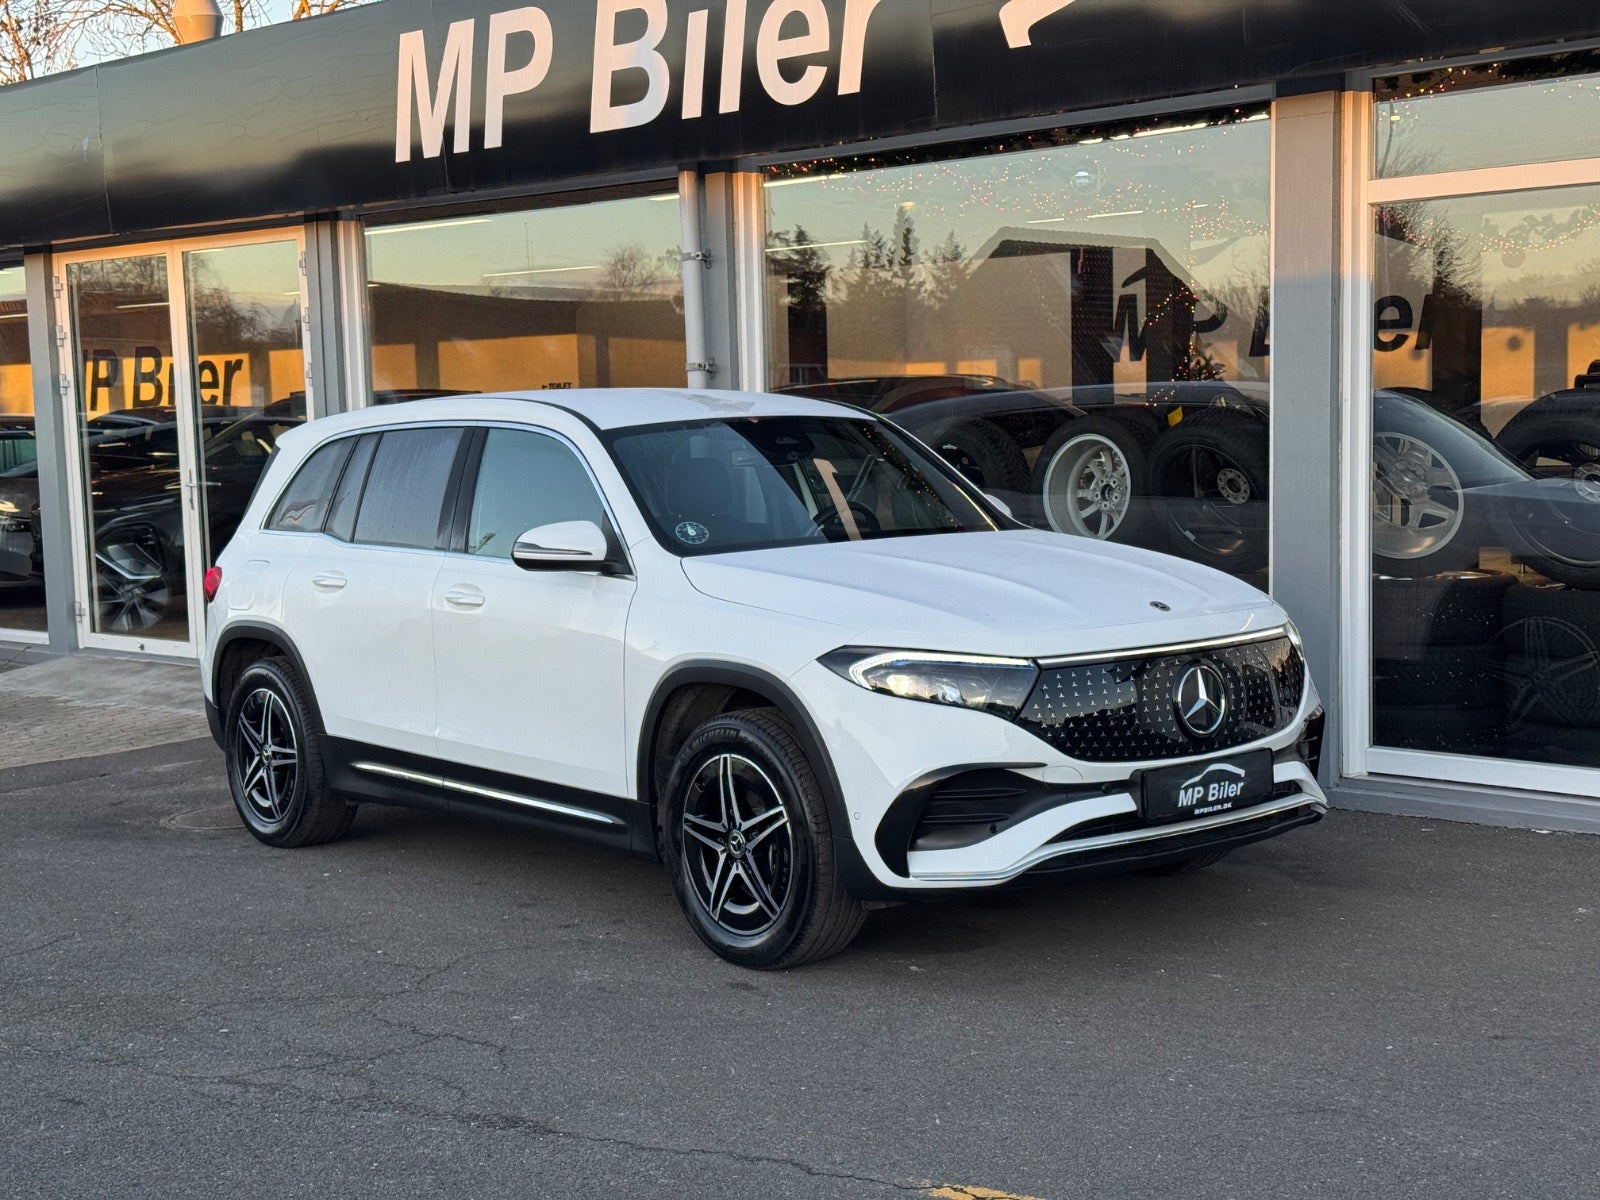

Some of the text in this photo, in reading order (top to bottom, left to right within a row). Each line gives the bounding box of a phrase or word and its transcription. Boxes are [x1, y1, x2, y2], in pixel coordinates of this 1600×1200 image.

[395, 0, 883, 163] MP Biler
[1178, 781, 1244, 807] MP Biler
